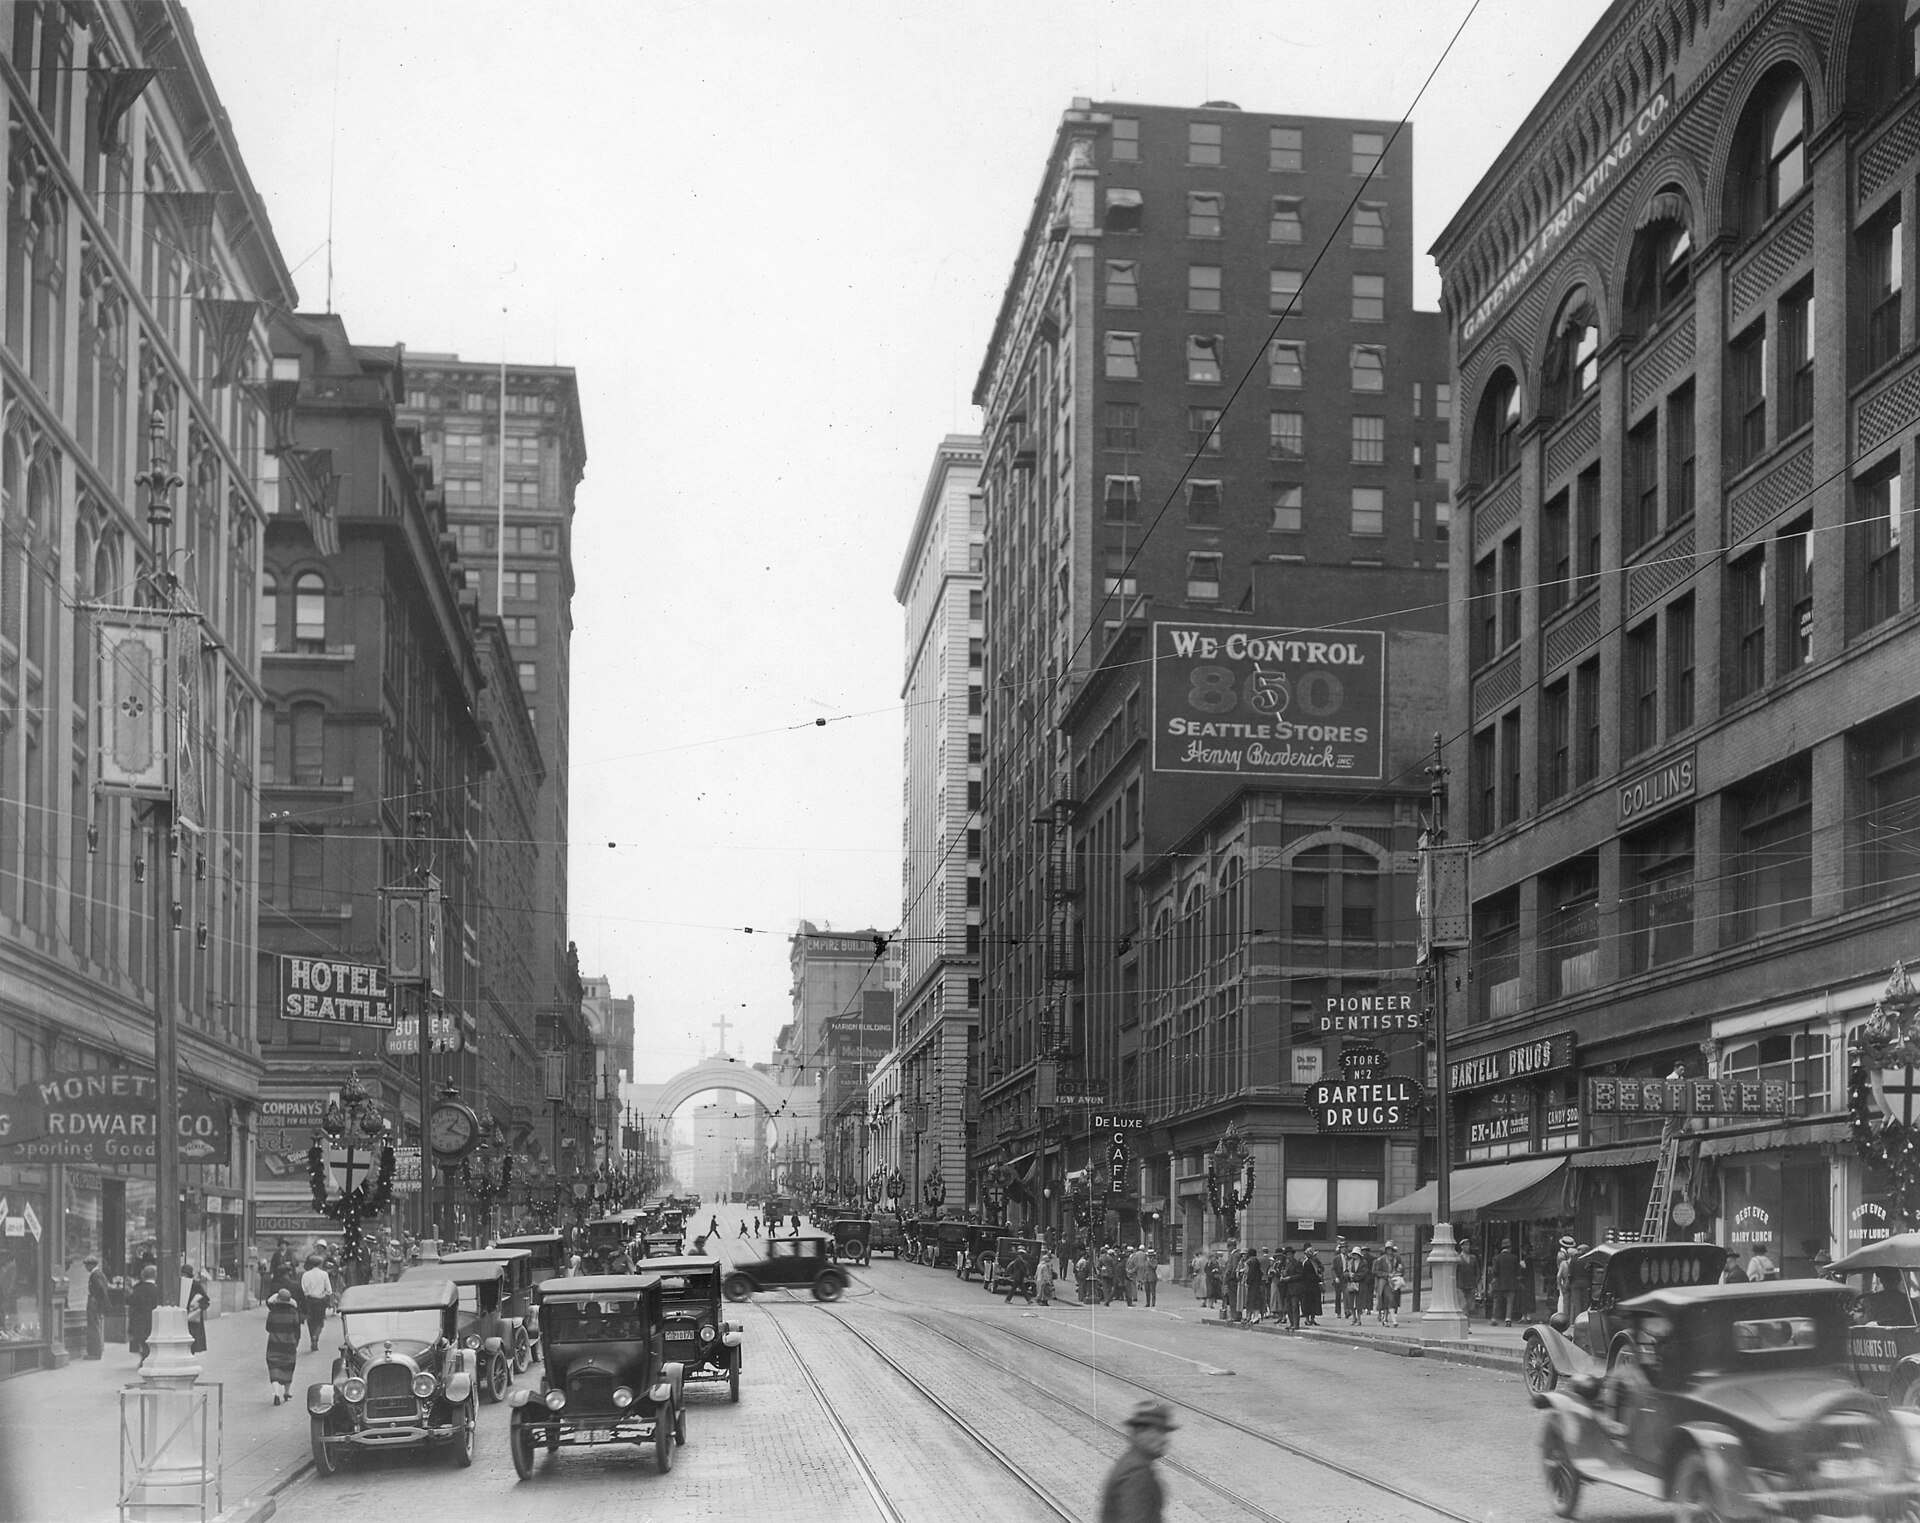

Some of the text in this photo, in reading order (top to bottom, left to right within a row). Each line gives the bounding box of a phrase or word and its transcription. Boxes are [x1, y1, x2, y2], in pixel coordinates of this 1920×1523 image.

[1463, 94, 1669, 341] GATEWAY PRINTING CO.
[1226, 633, 1365, 665] CONTROL
[1168, 717, 1368, 743] SEATTLE STORES
[1180, 740, 1243, 771] Henry
[1246, 742, 1335, 768] Broderick
[1622, 760, 1692, 816] COLLINS
[807, 940, 875, 952] EMPIRE BUILDIN
[290, 959, 388, 997] HOTEL
[285, 996, 393, 1024] SEATTLE
[1327, 996, 1411, 1012] PIONEER
[395, 1019, 450, 1036] BUTER
[1321, 1015, 1418, 1030] DENTISTS
[390, 1039, 419, 1051] HOTEL
[1345, 1055, 1380, 1066] STORE
[1452, 1055, 1499, 1088] BARTELL
[1509, 1041, 1551, 1075] DRUGS
[39, 1074, 188, 1108] MONETE
[1078, 1096, 1104, 1104] AVON
[1318, 1084, 1410, 1104] BARTELL
[1596, 1083, 1785, 1112] BEST EVER
[262, 1101, 323, 1115] COMPANY'S
[1327, 1106, 1400, 1126] DRUGS
[1548, 1107, 1578, 1124] CANDY SOD
[178, 1115, 220, 1136] CO.
[1472, 1120, 1508, 1142] EX-LAX
[14, 1139, 156, 1160] Sporting Good
[1112, 1132, 1124, 1192] CAFE
[1735, 1206, 1770, 1225] BEST EVER
[1852, 1203, 1887, 1221] BEST EVER
[255, 1218, 309, 1229] RUGGIST
[1732, 1231, 1773, 1242] DAIRY LUNCH
[1849, 1228, 1890, 1240] DAIRY LUNCH
[1884, 1340, 1898, 1359] LTD
